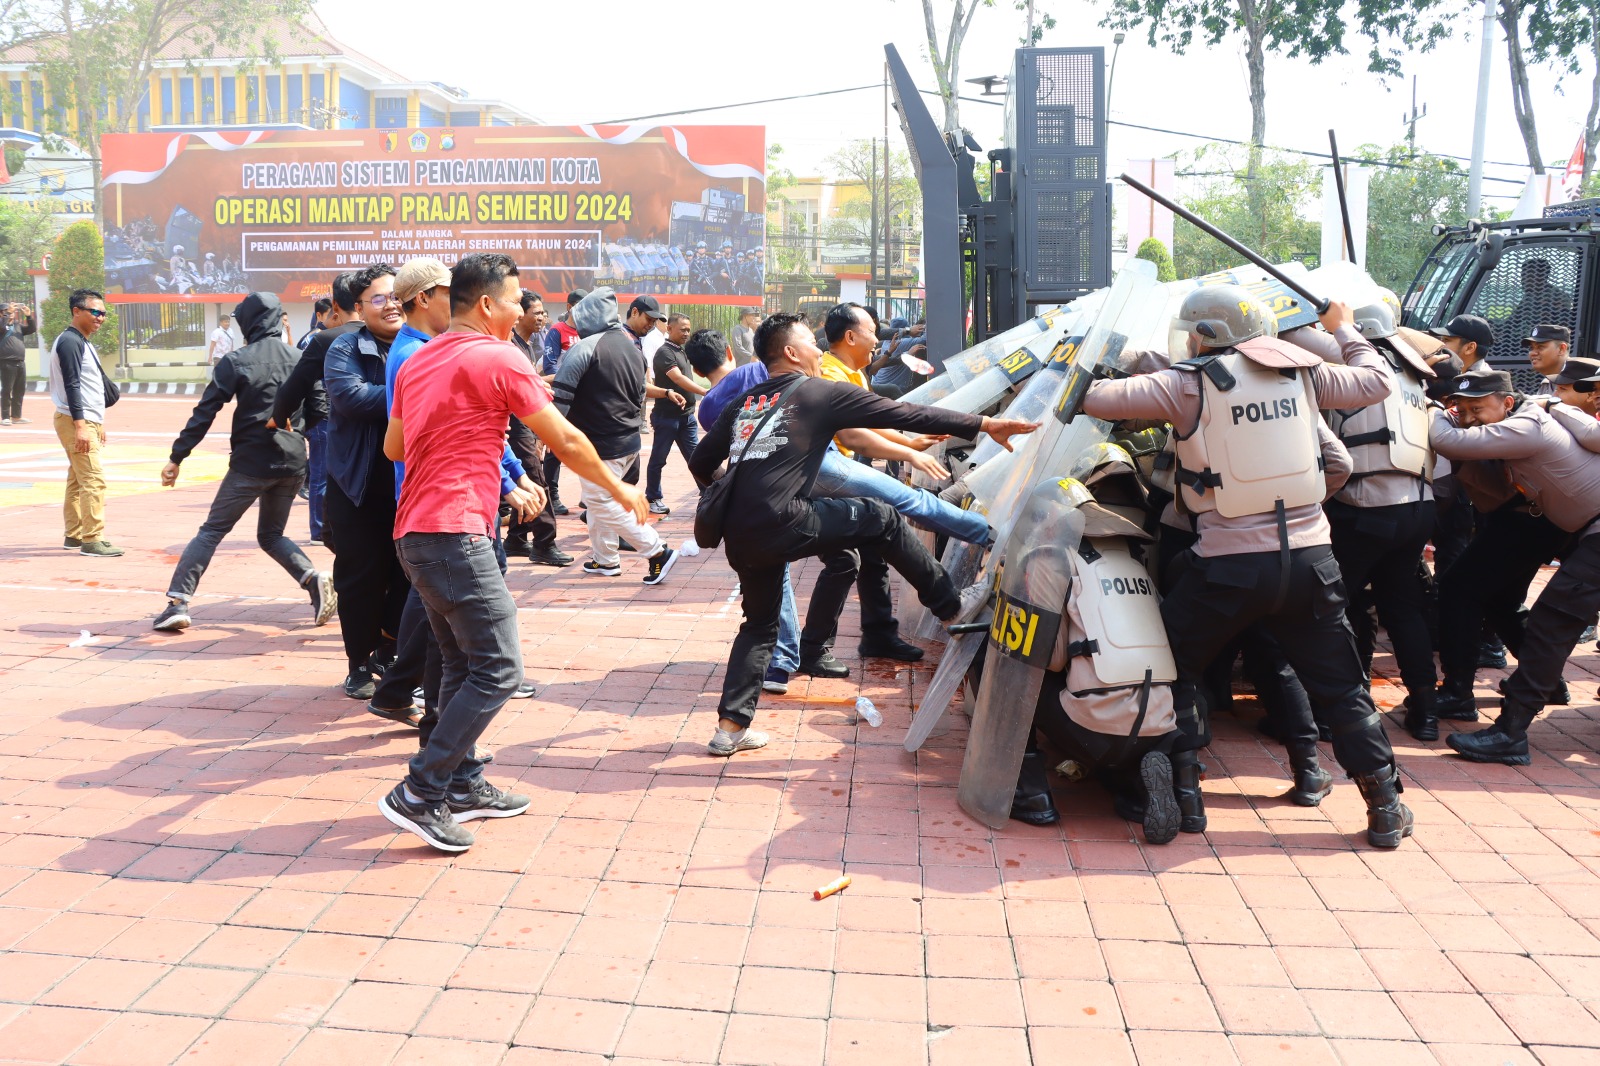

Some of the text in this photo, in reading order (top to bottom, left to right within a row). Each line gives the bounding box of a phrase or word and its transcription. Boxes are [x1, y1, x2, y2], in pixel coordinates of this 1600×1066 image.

[243, 157, 601, 189] PERAGAAN SISTEM PENGAMANAN KOTA
[214, 194, 632, 225] OPERASI MANTAP PRAJA SEMERU 2024
[381, 229, 453, 239] DALAM RANGKA
[250, 238, 592, 252] PENGAMANAN PEMILIHAN KEPALA DAERAH SERENTAK TAHUN 2024
[336, 254, 347, 265] DI
[350, 253, 395, 264] WILAYAH
[1231, 397, 1298, 426] POLISI
[1100, 577, 1152, 596] POLISI
